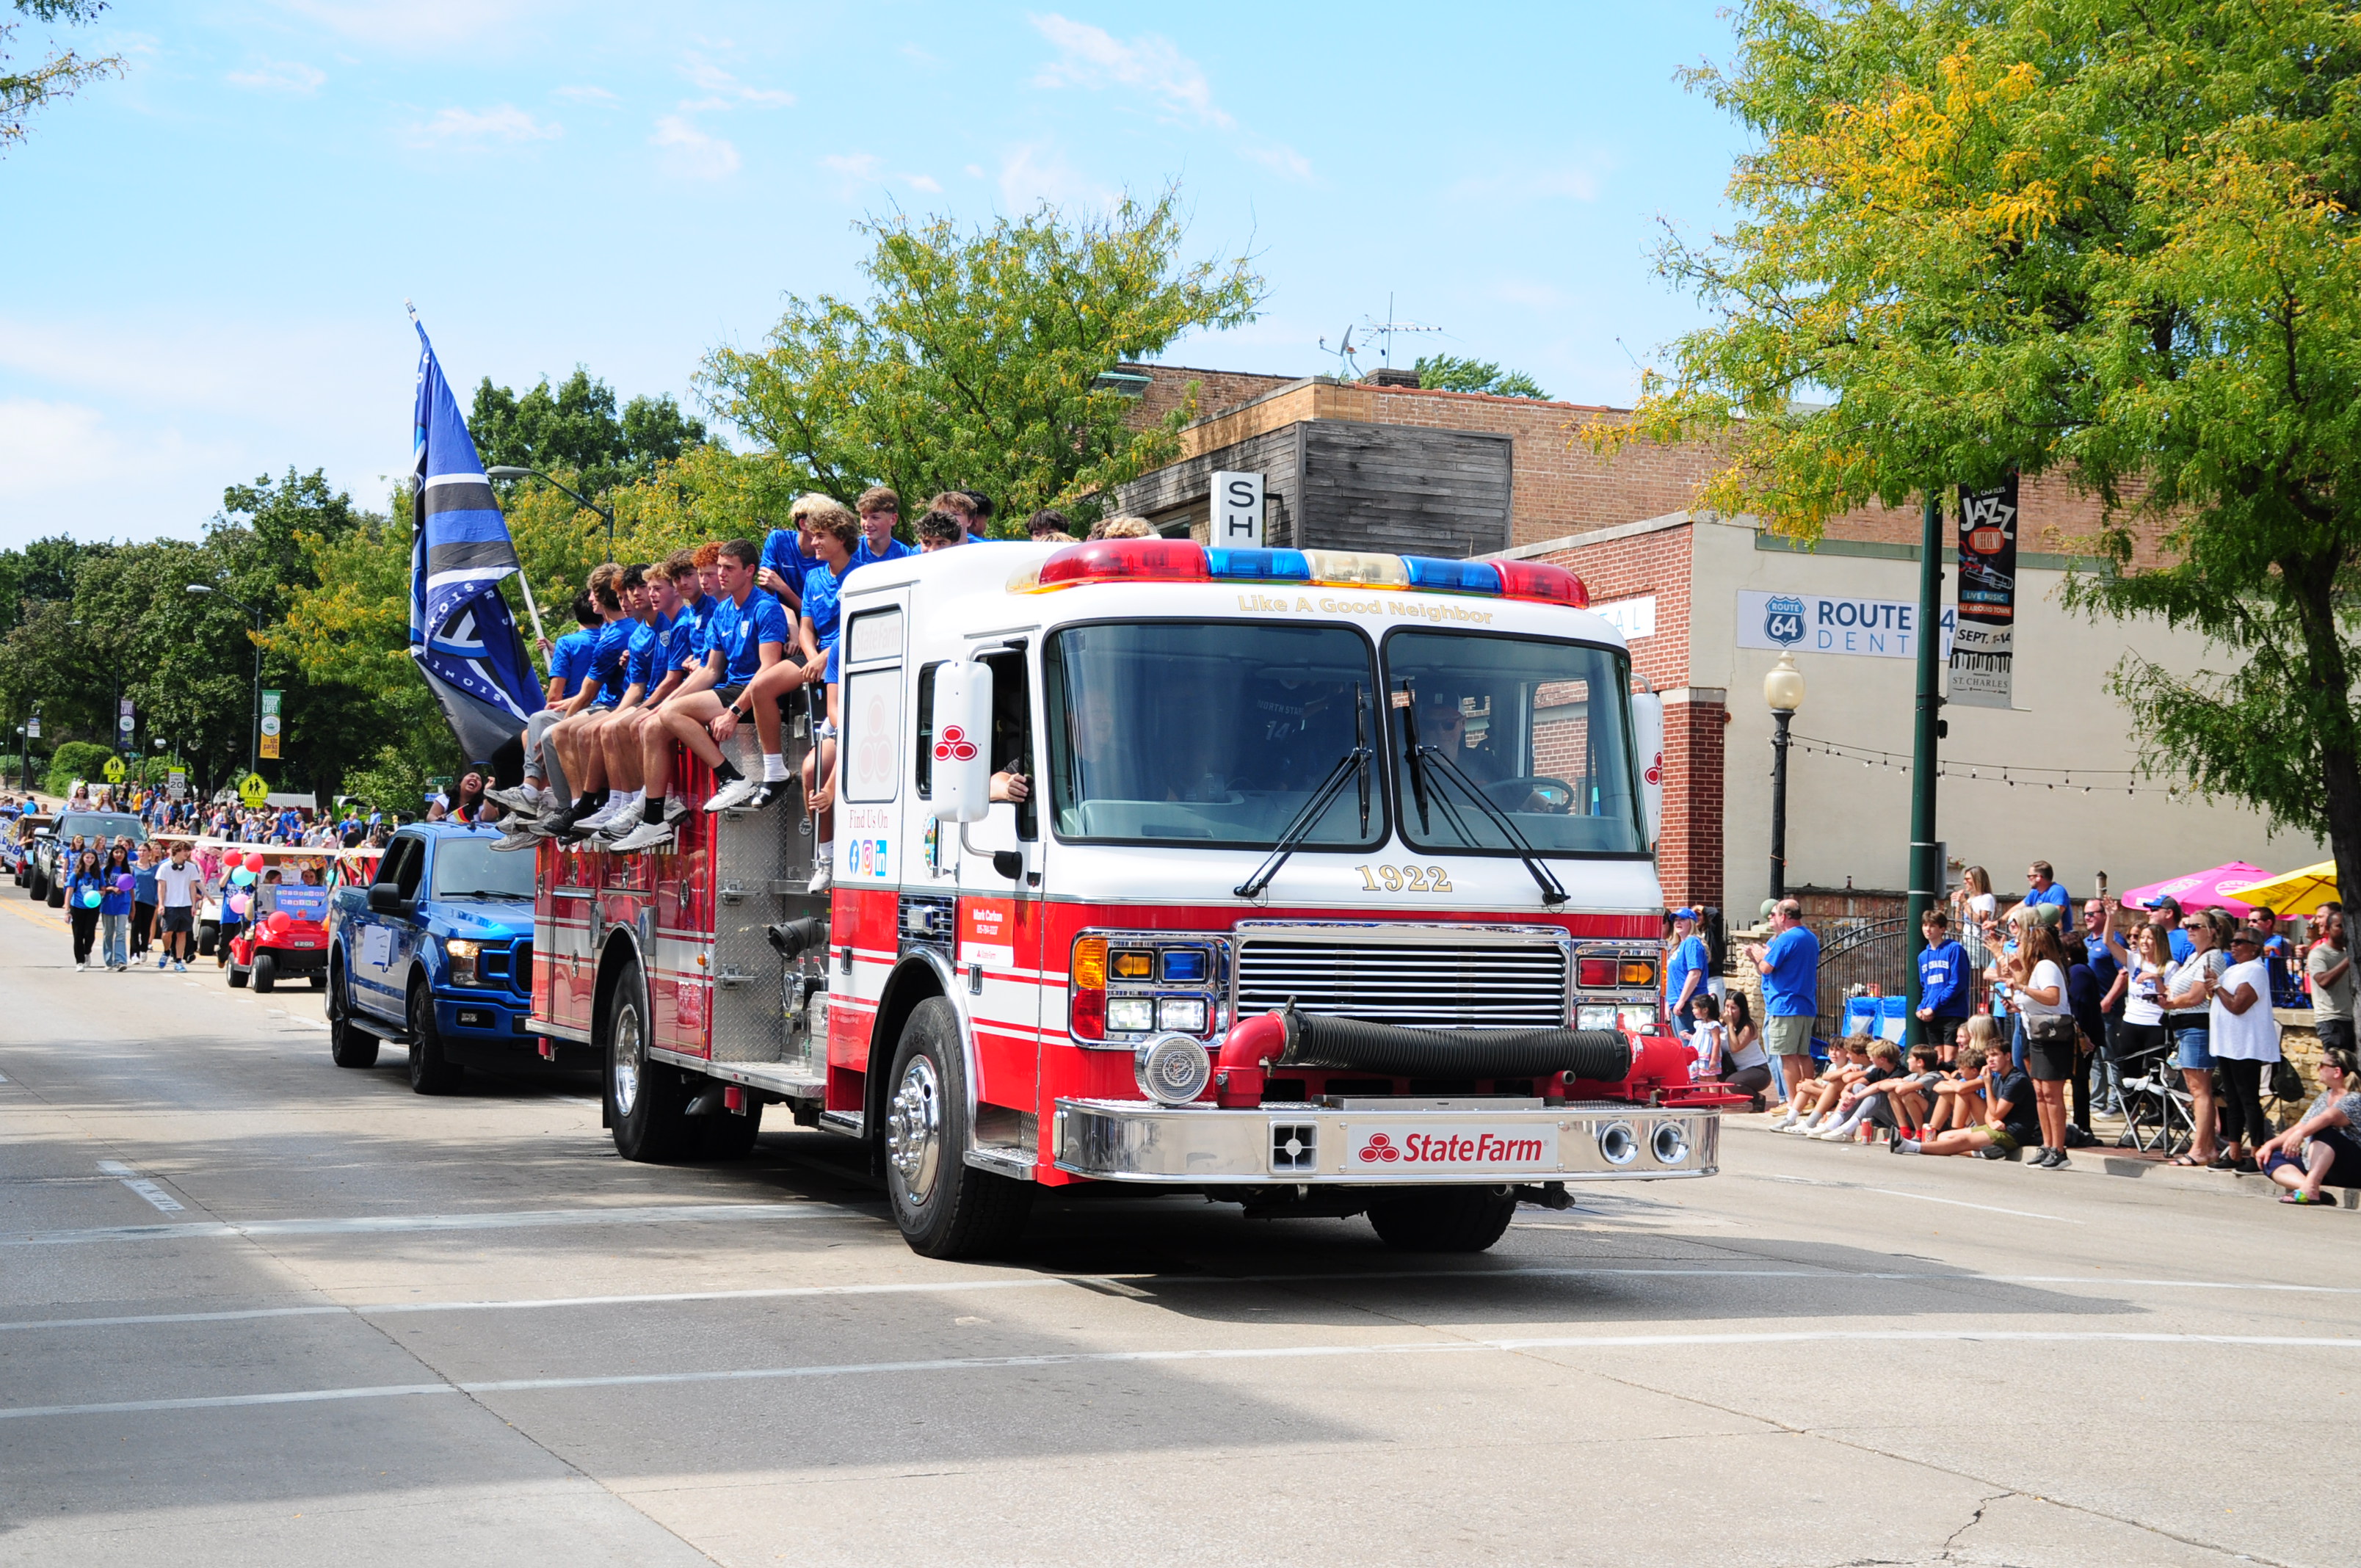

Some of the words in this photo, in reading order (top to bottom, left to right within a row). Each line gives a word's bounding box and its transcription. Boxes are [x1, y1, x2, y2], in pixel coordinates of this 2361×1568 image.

[1960, 497, 2016, 540] JAZZ
[1974, 531, 2001, 550] WEEKEND
[1967, 592, 1981, 600] LIVE
[1984, 592, 2004, 602] MUSIC
[1238, 595, 1287, 611] Like
[1296, 596, 1313, 612] A
[1319, 598, 1382, 615] Good
[1389, 601, 1493, 625] Neighbor
[1771, 602, 1799, 613] ROUTE
[1818, 600, 1912, 631] ROUTE
[1959, 603, 1968, 611] ALL
[1969, 604, 1992, 613] AROUND
[1993, 606, 2010, 614] TOWN
[1770, 615, 1798, 637] 64
[1818, 629, 1953, 658] DENTL
[1957, 629, 1989, 645] SEPT.
[1952, 677, 1965, 685] ST.
[1966, 678, 2008, 689] CHARLES
[1256, 699, 1284, 714] NORTH
[1265, 719, 1291, 741] 14
[849, 809, 865, 828] Find
[867, 809, 876, 828] Us
[877, 809, 888, 828] On
[1355, 865, 1453, 893] 1922
[973, 908, 984, 921] Mark
[985, 910, 1003, 922] Carlson
